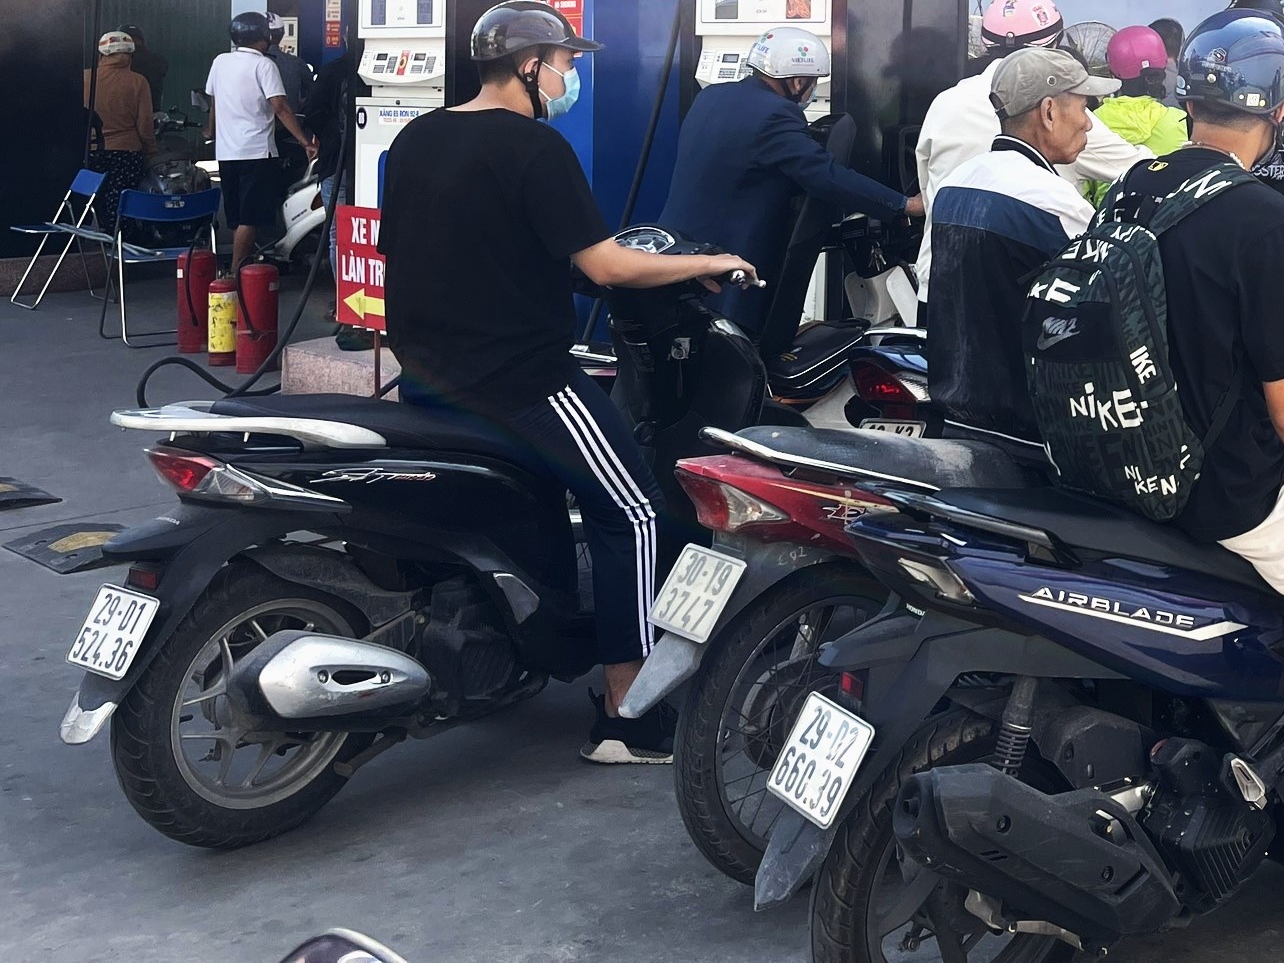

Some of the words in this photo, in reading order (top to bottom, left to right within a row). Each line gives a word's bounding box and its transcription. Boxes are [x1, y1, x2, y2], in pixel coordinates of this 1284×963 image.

[351, 216, 367, 246] XE
[341, 249, 365, 285] LÀN
[368, 256, 386, 288] TR
[93, 593, 147, 636] 29-D1
[1031, 587, 1195, 629] AIRBLADE
